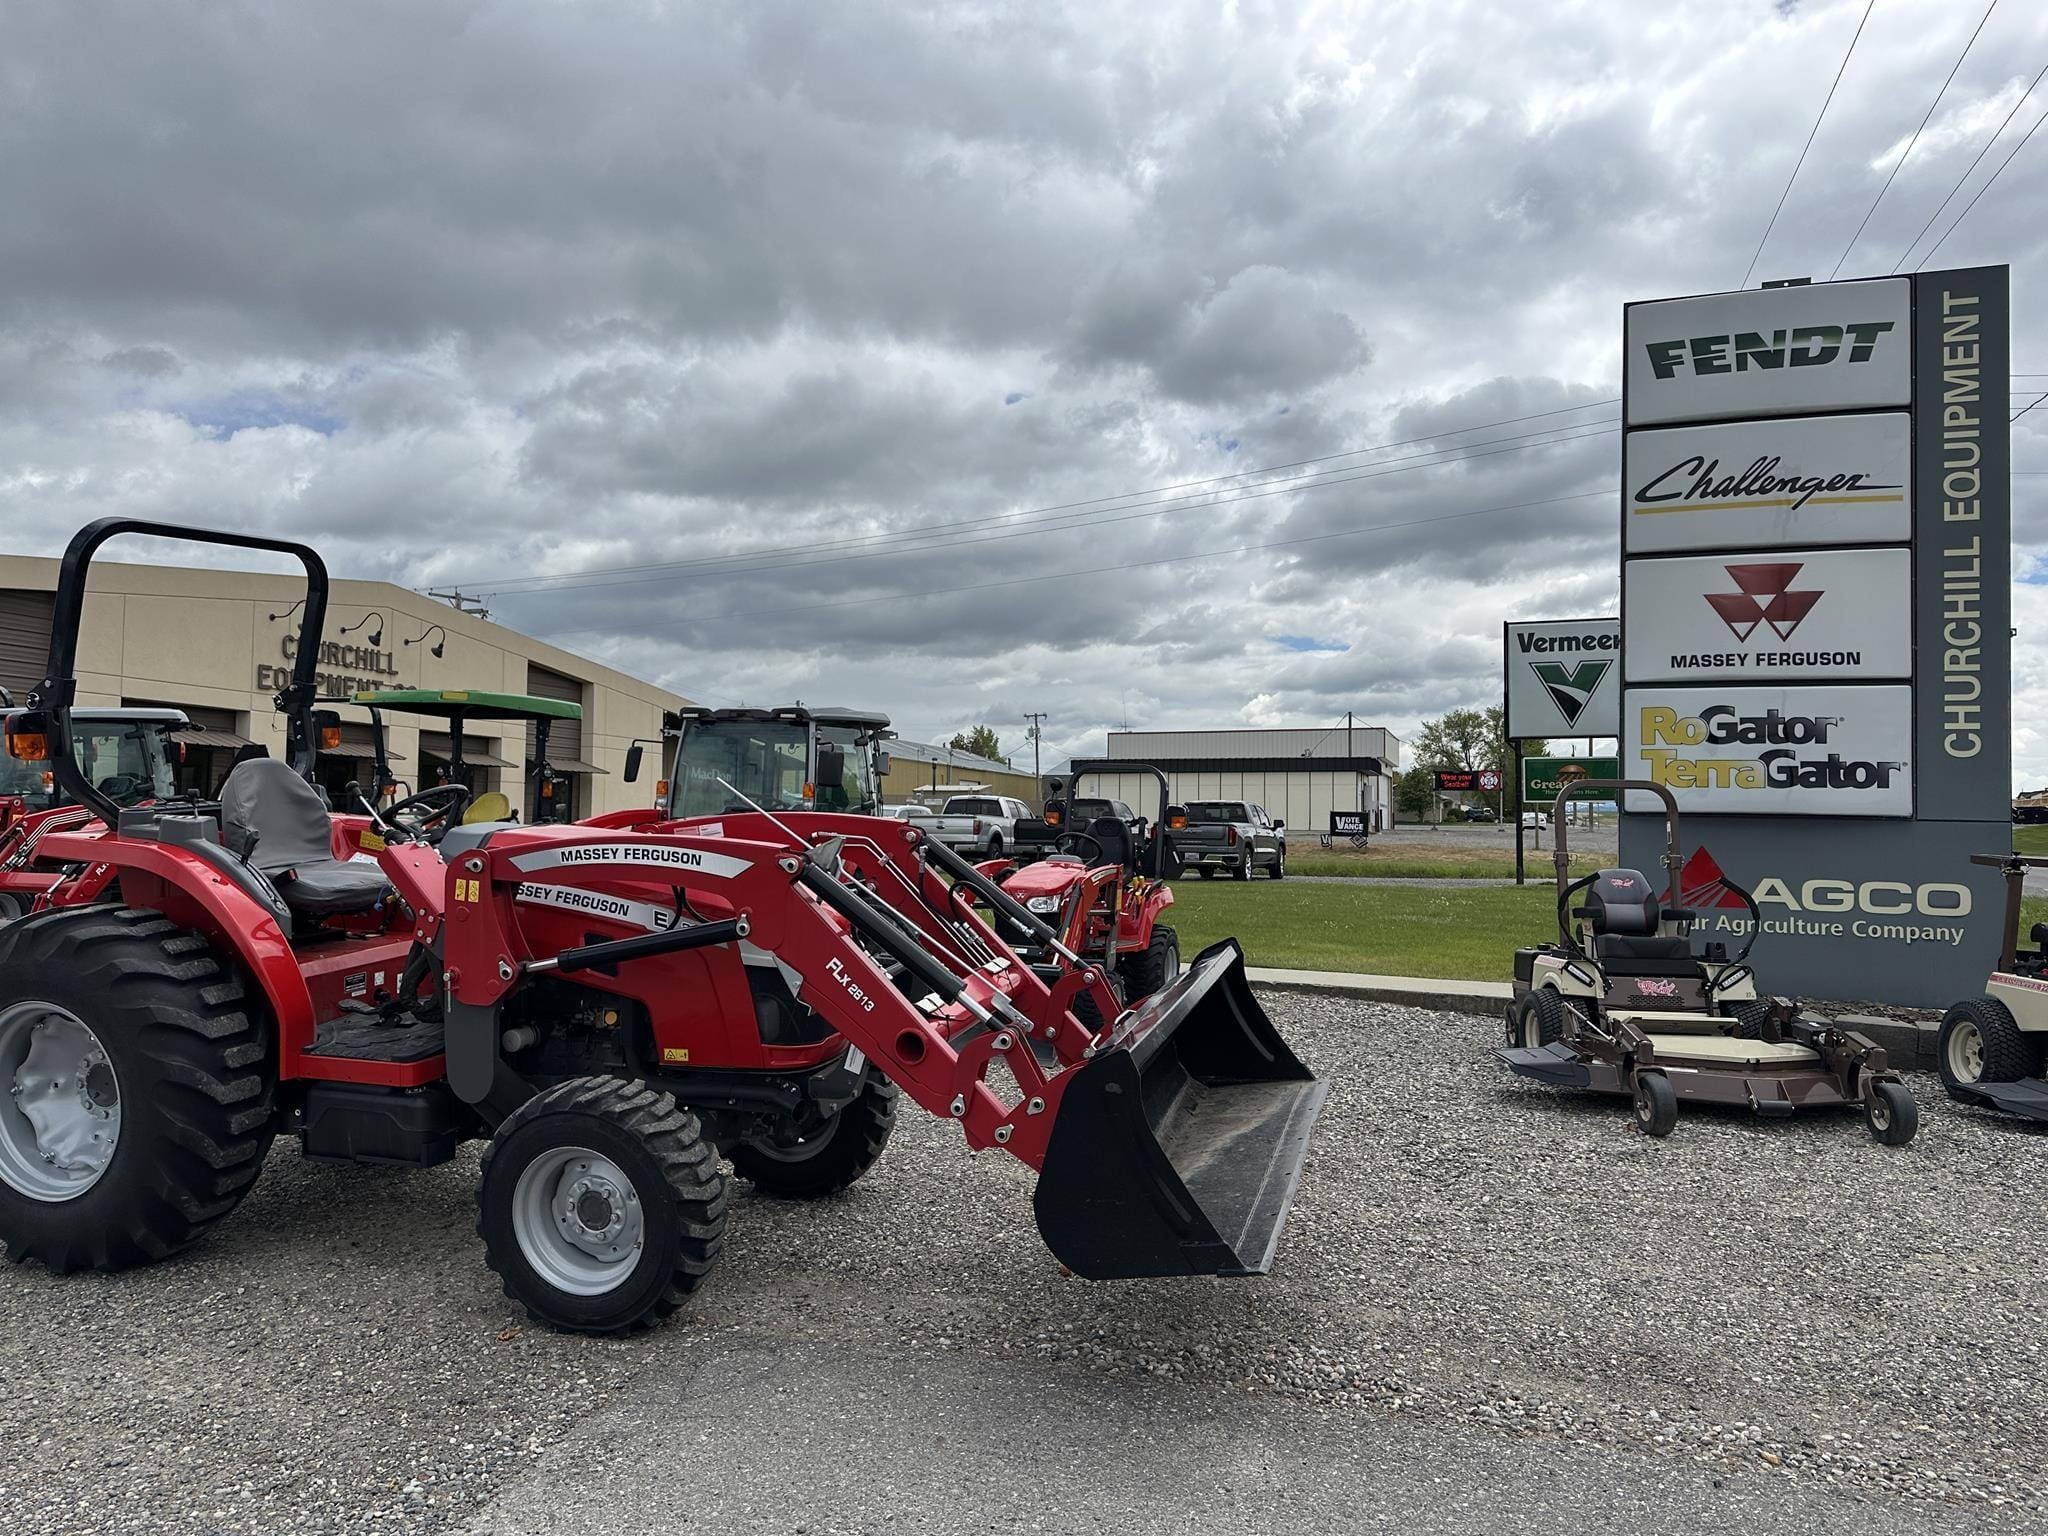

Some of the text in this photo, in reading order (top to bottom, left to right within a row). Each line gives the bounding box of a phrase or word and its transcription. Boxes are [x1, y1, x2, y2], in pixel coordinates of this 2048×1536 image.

[1646, 321, 1895, 379] FENDT
[1634, 456, 1903, 511] Challenger
[1943, 291, 1982, 758] CHURCHILL EQUIPMENT
[282, 635, 399, 675] CURCHILL
[1517, 632, 1619, 653] Vermeer
[1670, 651, 1861, 669] MASSEY FERGUSON
[1641, 705, 1838, 745] RoGator
[1641, 749, 1901, 789] TerraGator
[560, 847, 702, 867] MASSEY FERGUSON
[517, 884, 553, 900] SSEY
[555, 890, 630, 917] FERGUSON
[1751, 878, 1972, 918] AGCO
[1715, 914, 1843, 937] Agriculture
[1852, 920, 1965, 946] Company
[825, 957, 852, 987] FLX
[847, 983, 875, 1012] 2813
